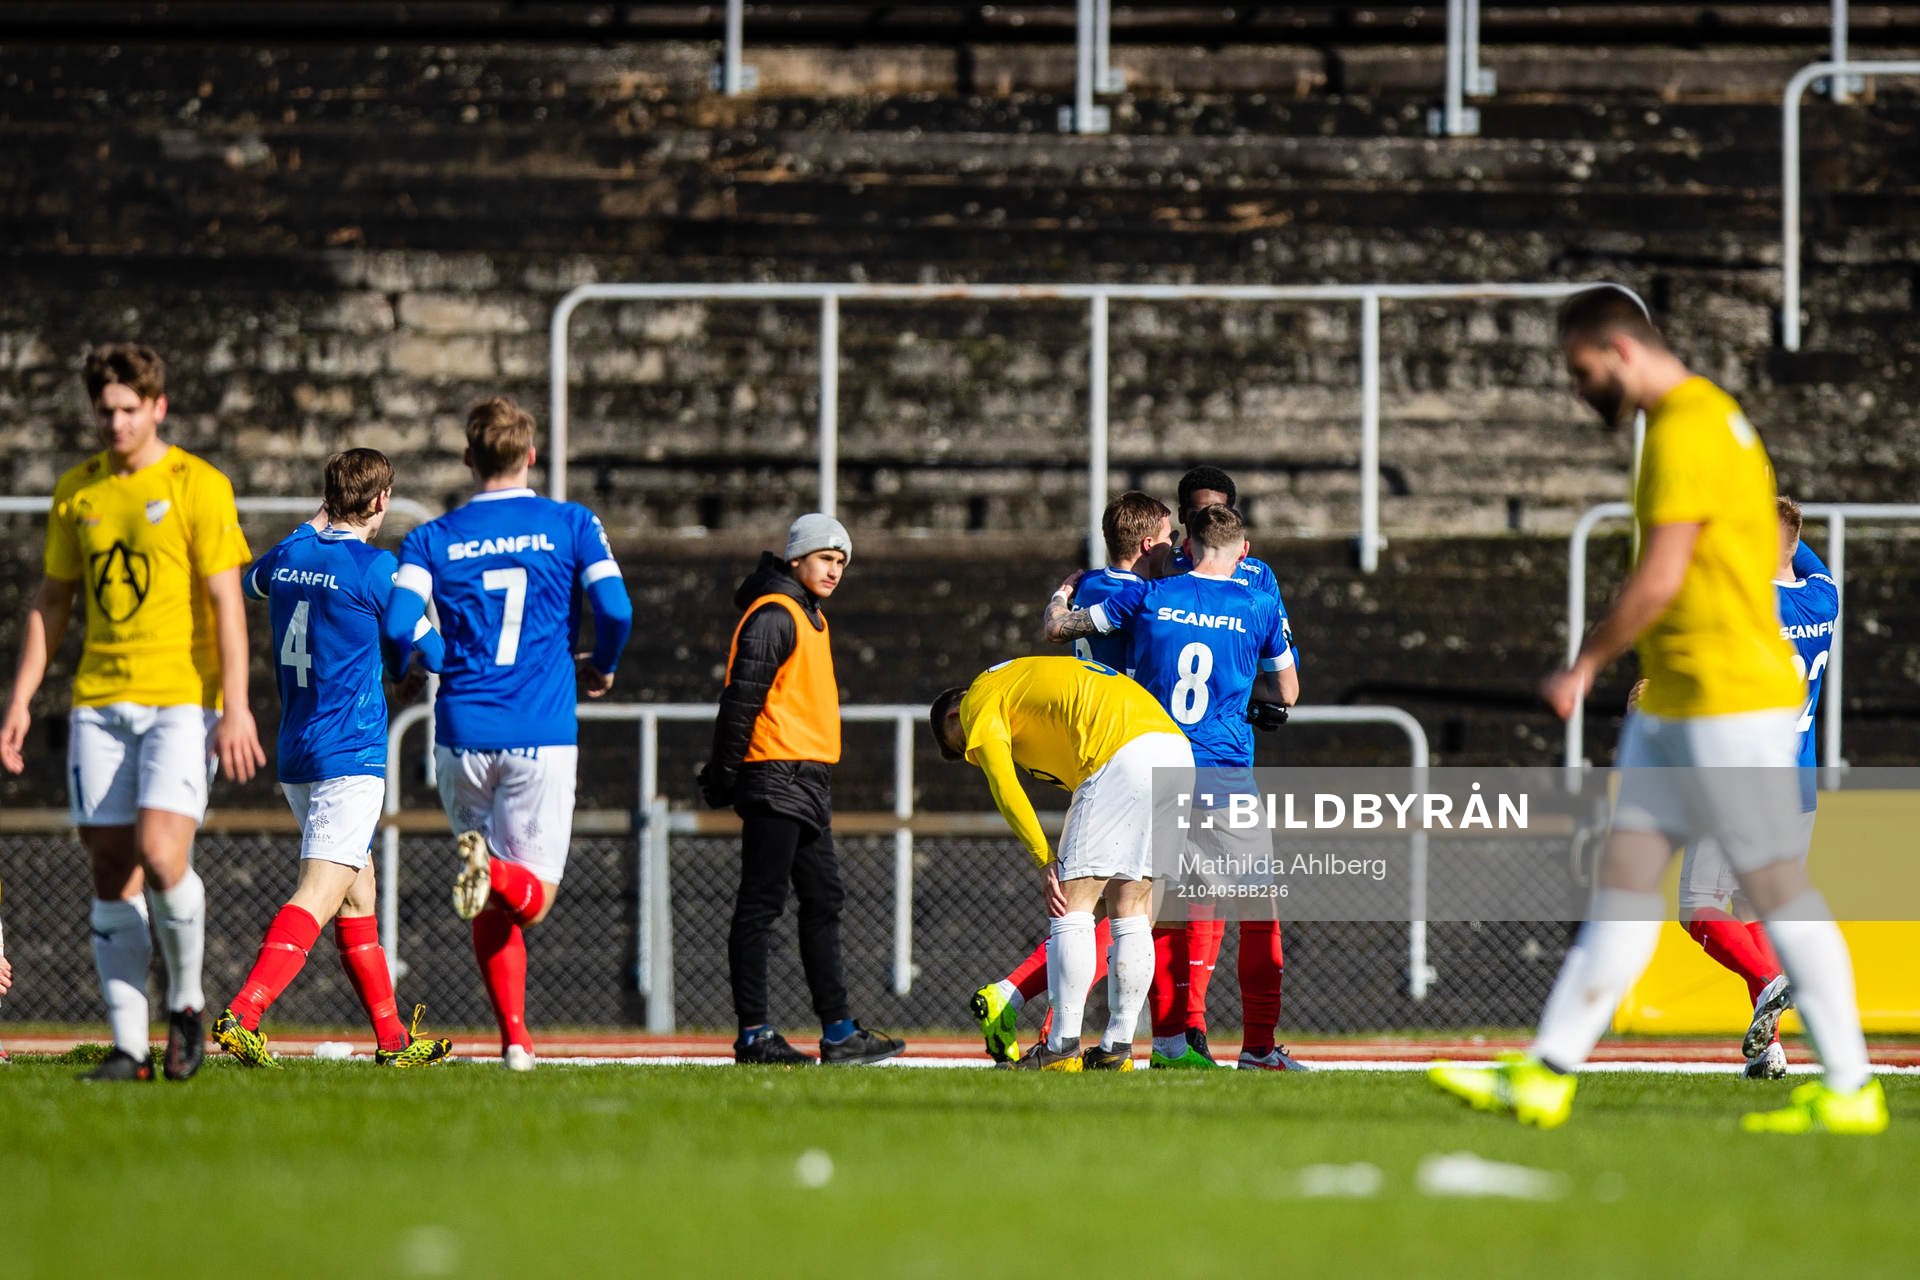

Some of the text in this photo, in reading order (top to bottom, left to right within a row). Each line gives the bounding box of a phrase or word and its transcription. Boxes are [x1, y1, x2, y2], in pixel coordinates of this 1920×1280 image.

[447, 533, 555, 561] SCANFIL
[271, 568, 339, 590] SCANFIL
[281, 600, 311, 688] 4
[482, 567, 528, 666] 7
[1157, 607, 1247, 633] SCANFIL
[1171, 642, 1213, 725] 8
